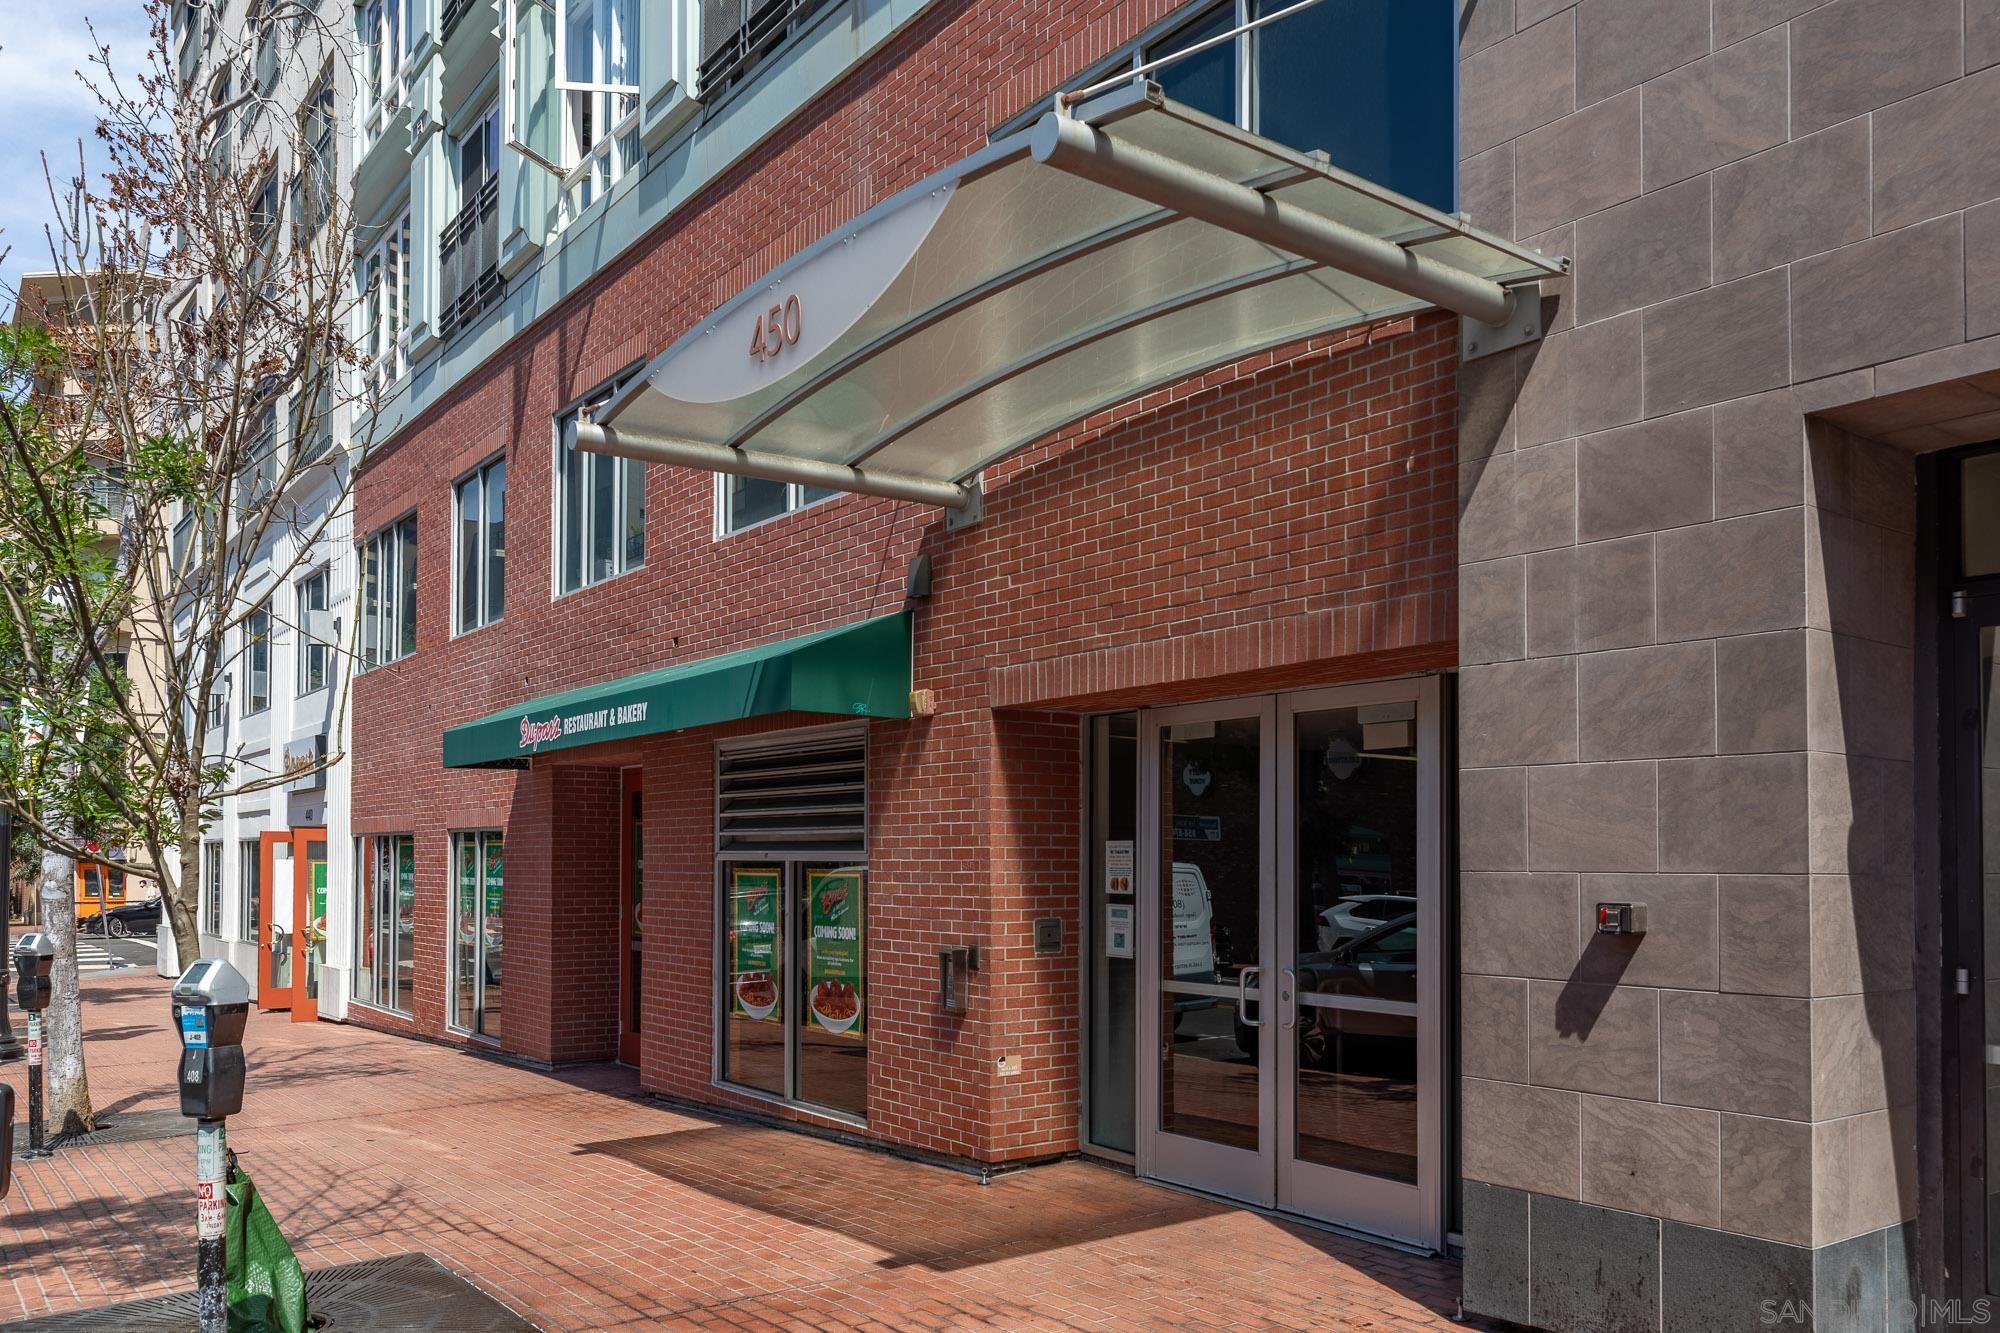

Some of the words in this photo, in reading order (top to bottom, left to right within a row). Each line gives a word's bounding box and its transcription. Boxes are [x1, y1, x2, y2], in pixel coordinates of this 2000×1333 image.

[749, 293, 801, 362] 450
[563, 709, 608, 735] RESTAURANT
[609, 707, 616, 726] &
[617, 702, 648, 724] BAKERY
[814, 925, 837, 939] COMING
[838, 926, 857, 940] SOON!
[186, 1070, 200, 1082] 408
